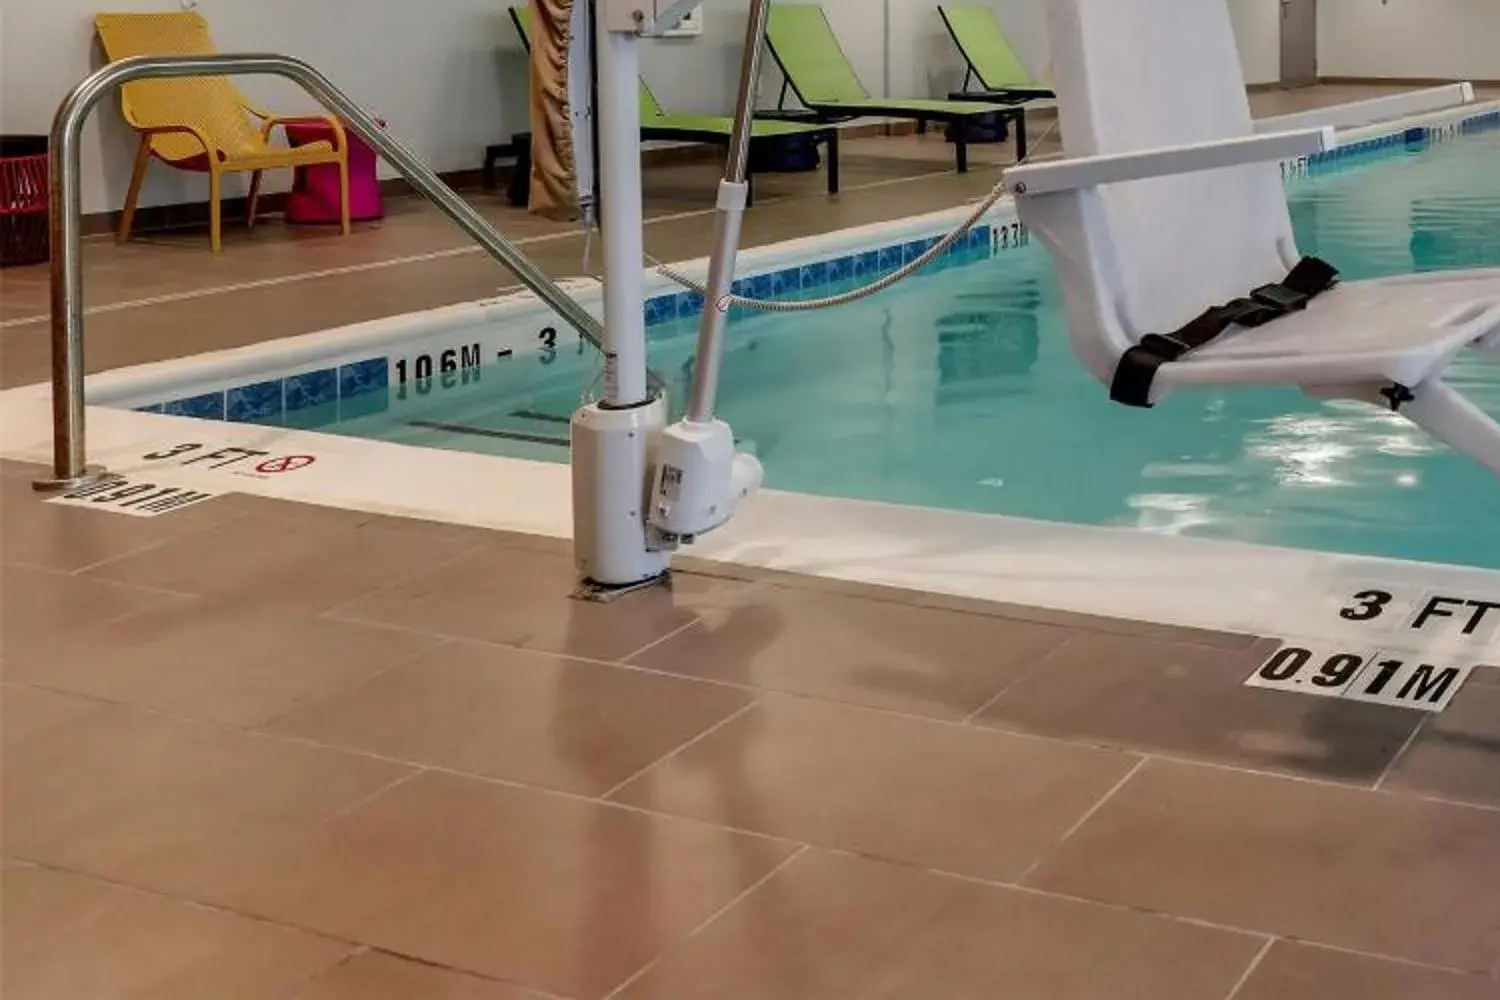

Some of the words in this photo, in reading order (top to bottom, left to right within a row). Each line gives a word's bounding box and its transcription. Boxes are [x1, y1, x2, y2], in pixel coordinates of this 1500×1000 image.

[143, 443, 203, 461] 3
[181, 446, 269, 471] FT
[1340, 590, 1393, 621] 3
[1258, 646, 1460, 703] 0.91M
